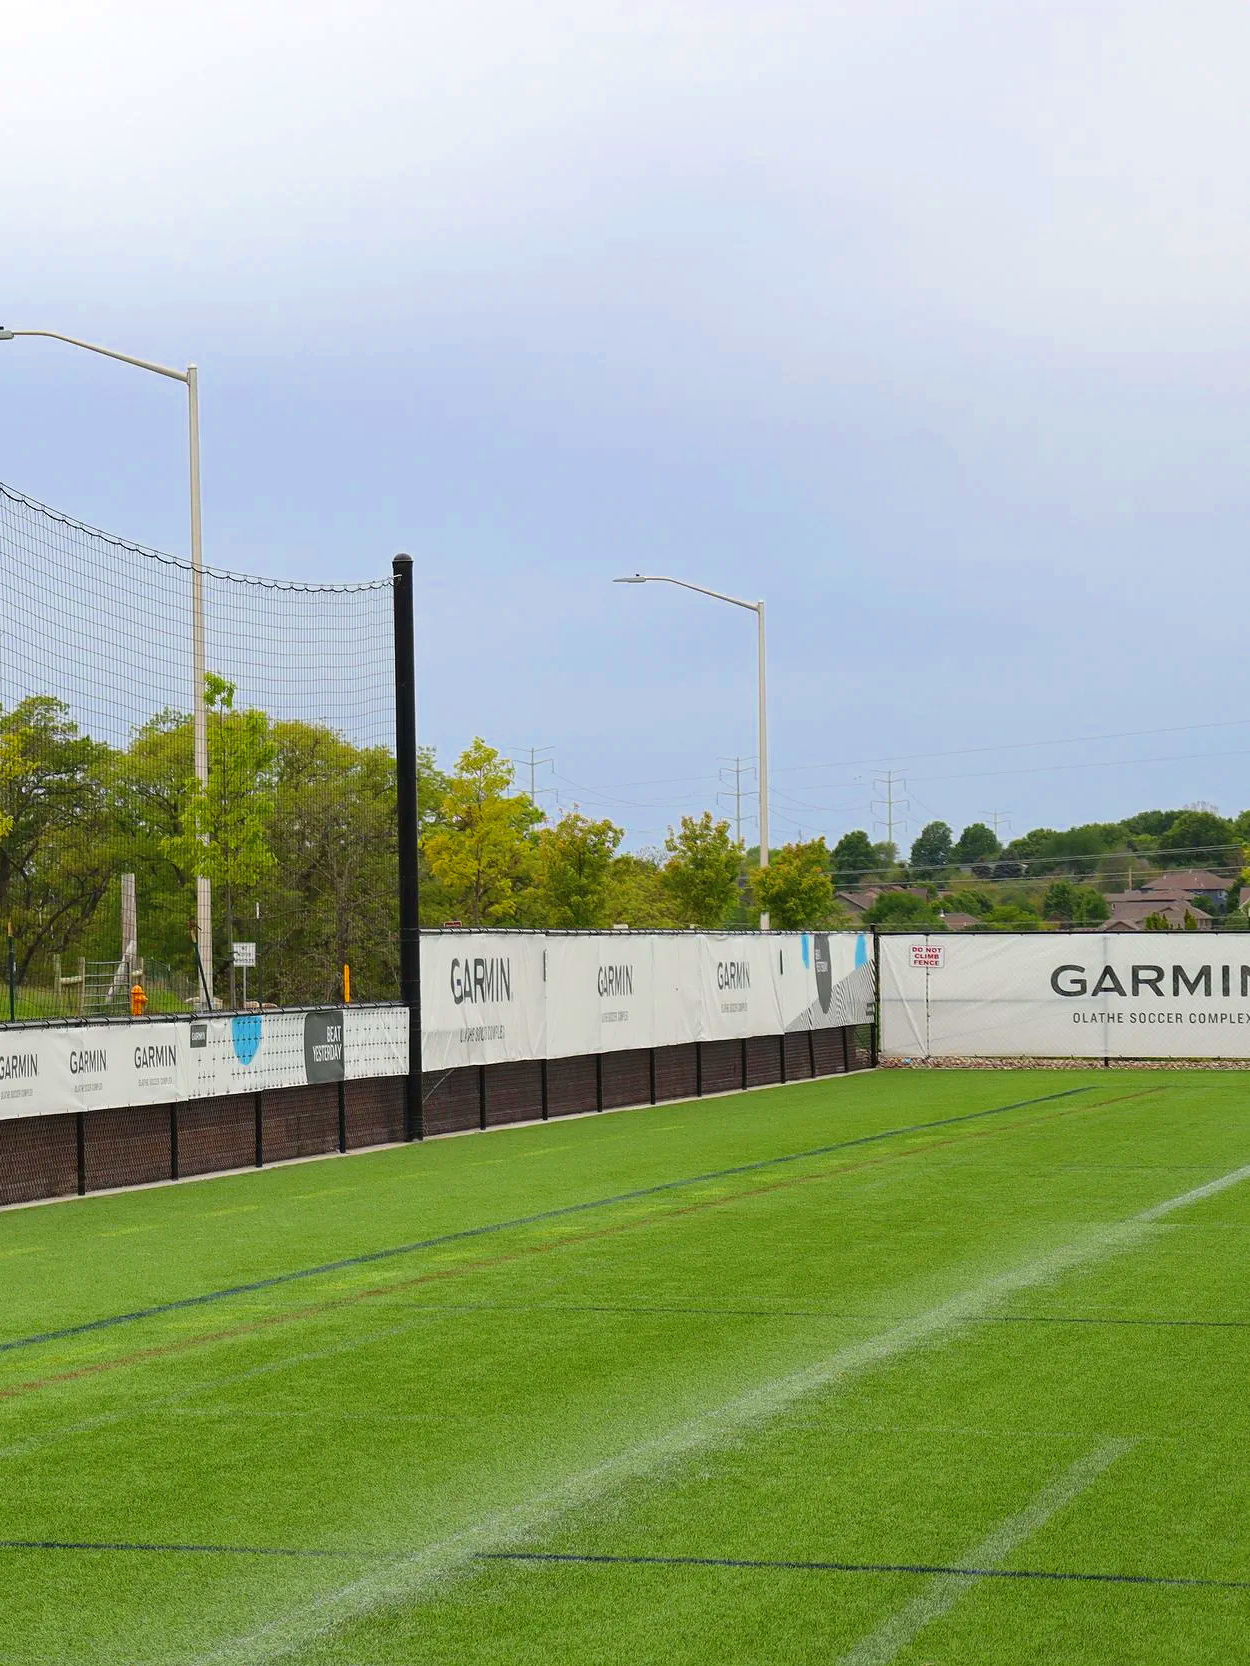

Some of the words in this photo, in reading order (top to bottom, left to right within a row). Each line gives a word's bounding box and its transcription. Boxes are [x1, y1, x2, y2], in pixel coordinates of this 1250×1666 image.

[451, 957, 511, 1005] GARMIN
[597, 964, 633, 997] GARMIN
[717, 961, 751, 990] GARMIN
[1072, 1012, 1124, 1024] OLATHE
[1129, 1012, 1183, 1024] SOCCER
[326, 1025, 341, 1042] BEAT
[70, 1049, 107, 1074] GARMIN
[134, 1045, 176, 1069] GARMIN
[312, 1044, 342, 1062] YESTERDAY
